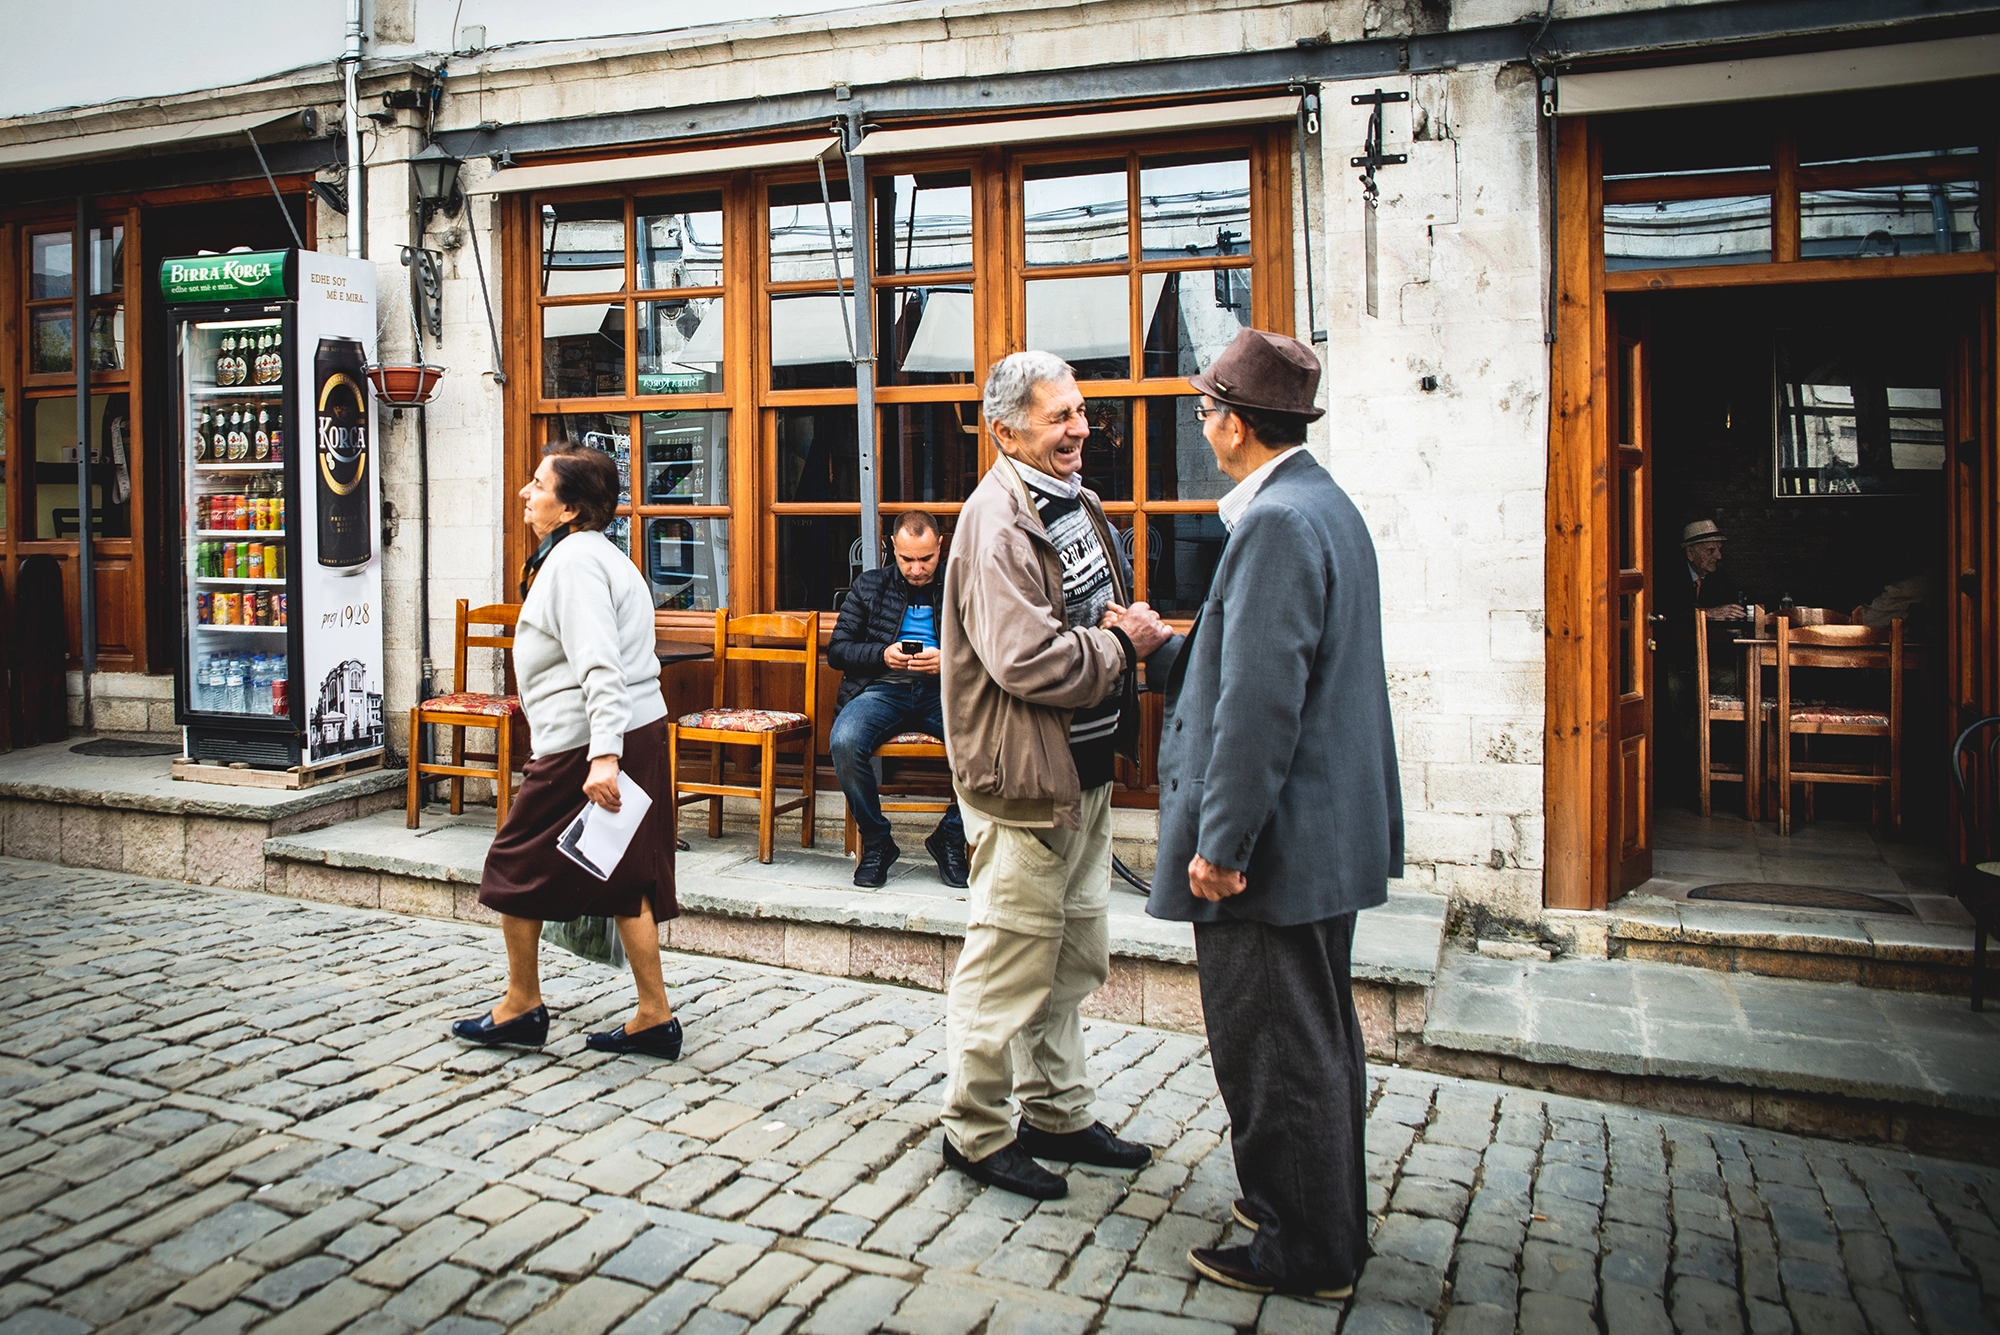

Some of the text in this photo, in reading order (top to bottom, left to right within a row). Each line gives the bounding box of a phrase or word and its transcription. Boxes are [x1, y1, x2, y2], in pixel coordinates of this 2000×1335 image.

[170, 260, 272, 286] BIRRA KORÇA
[311, 273, 347, 287] EDHE SOT
[171, 285, 188, 294] edhe
[326, 288, 338, 300] MË
[339, 291, 344, 301] E
[318, 416, 366, 462] KORÇA
[340, 602, 370, 629] 1928
